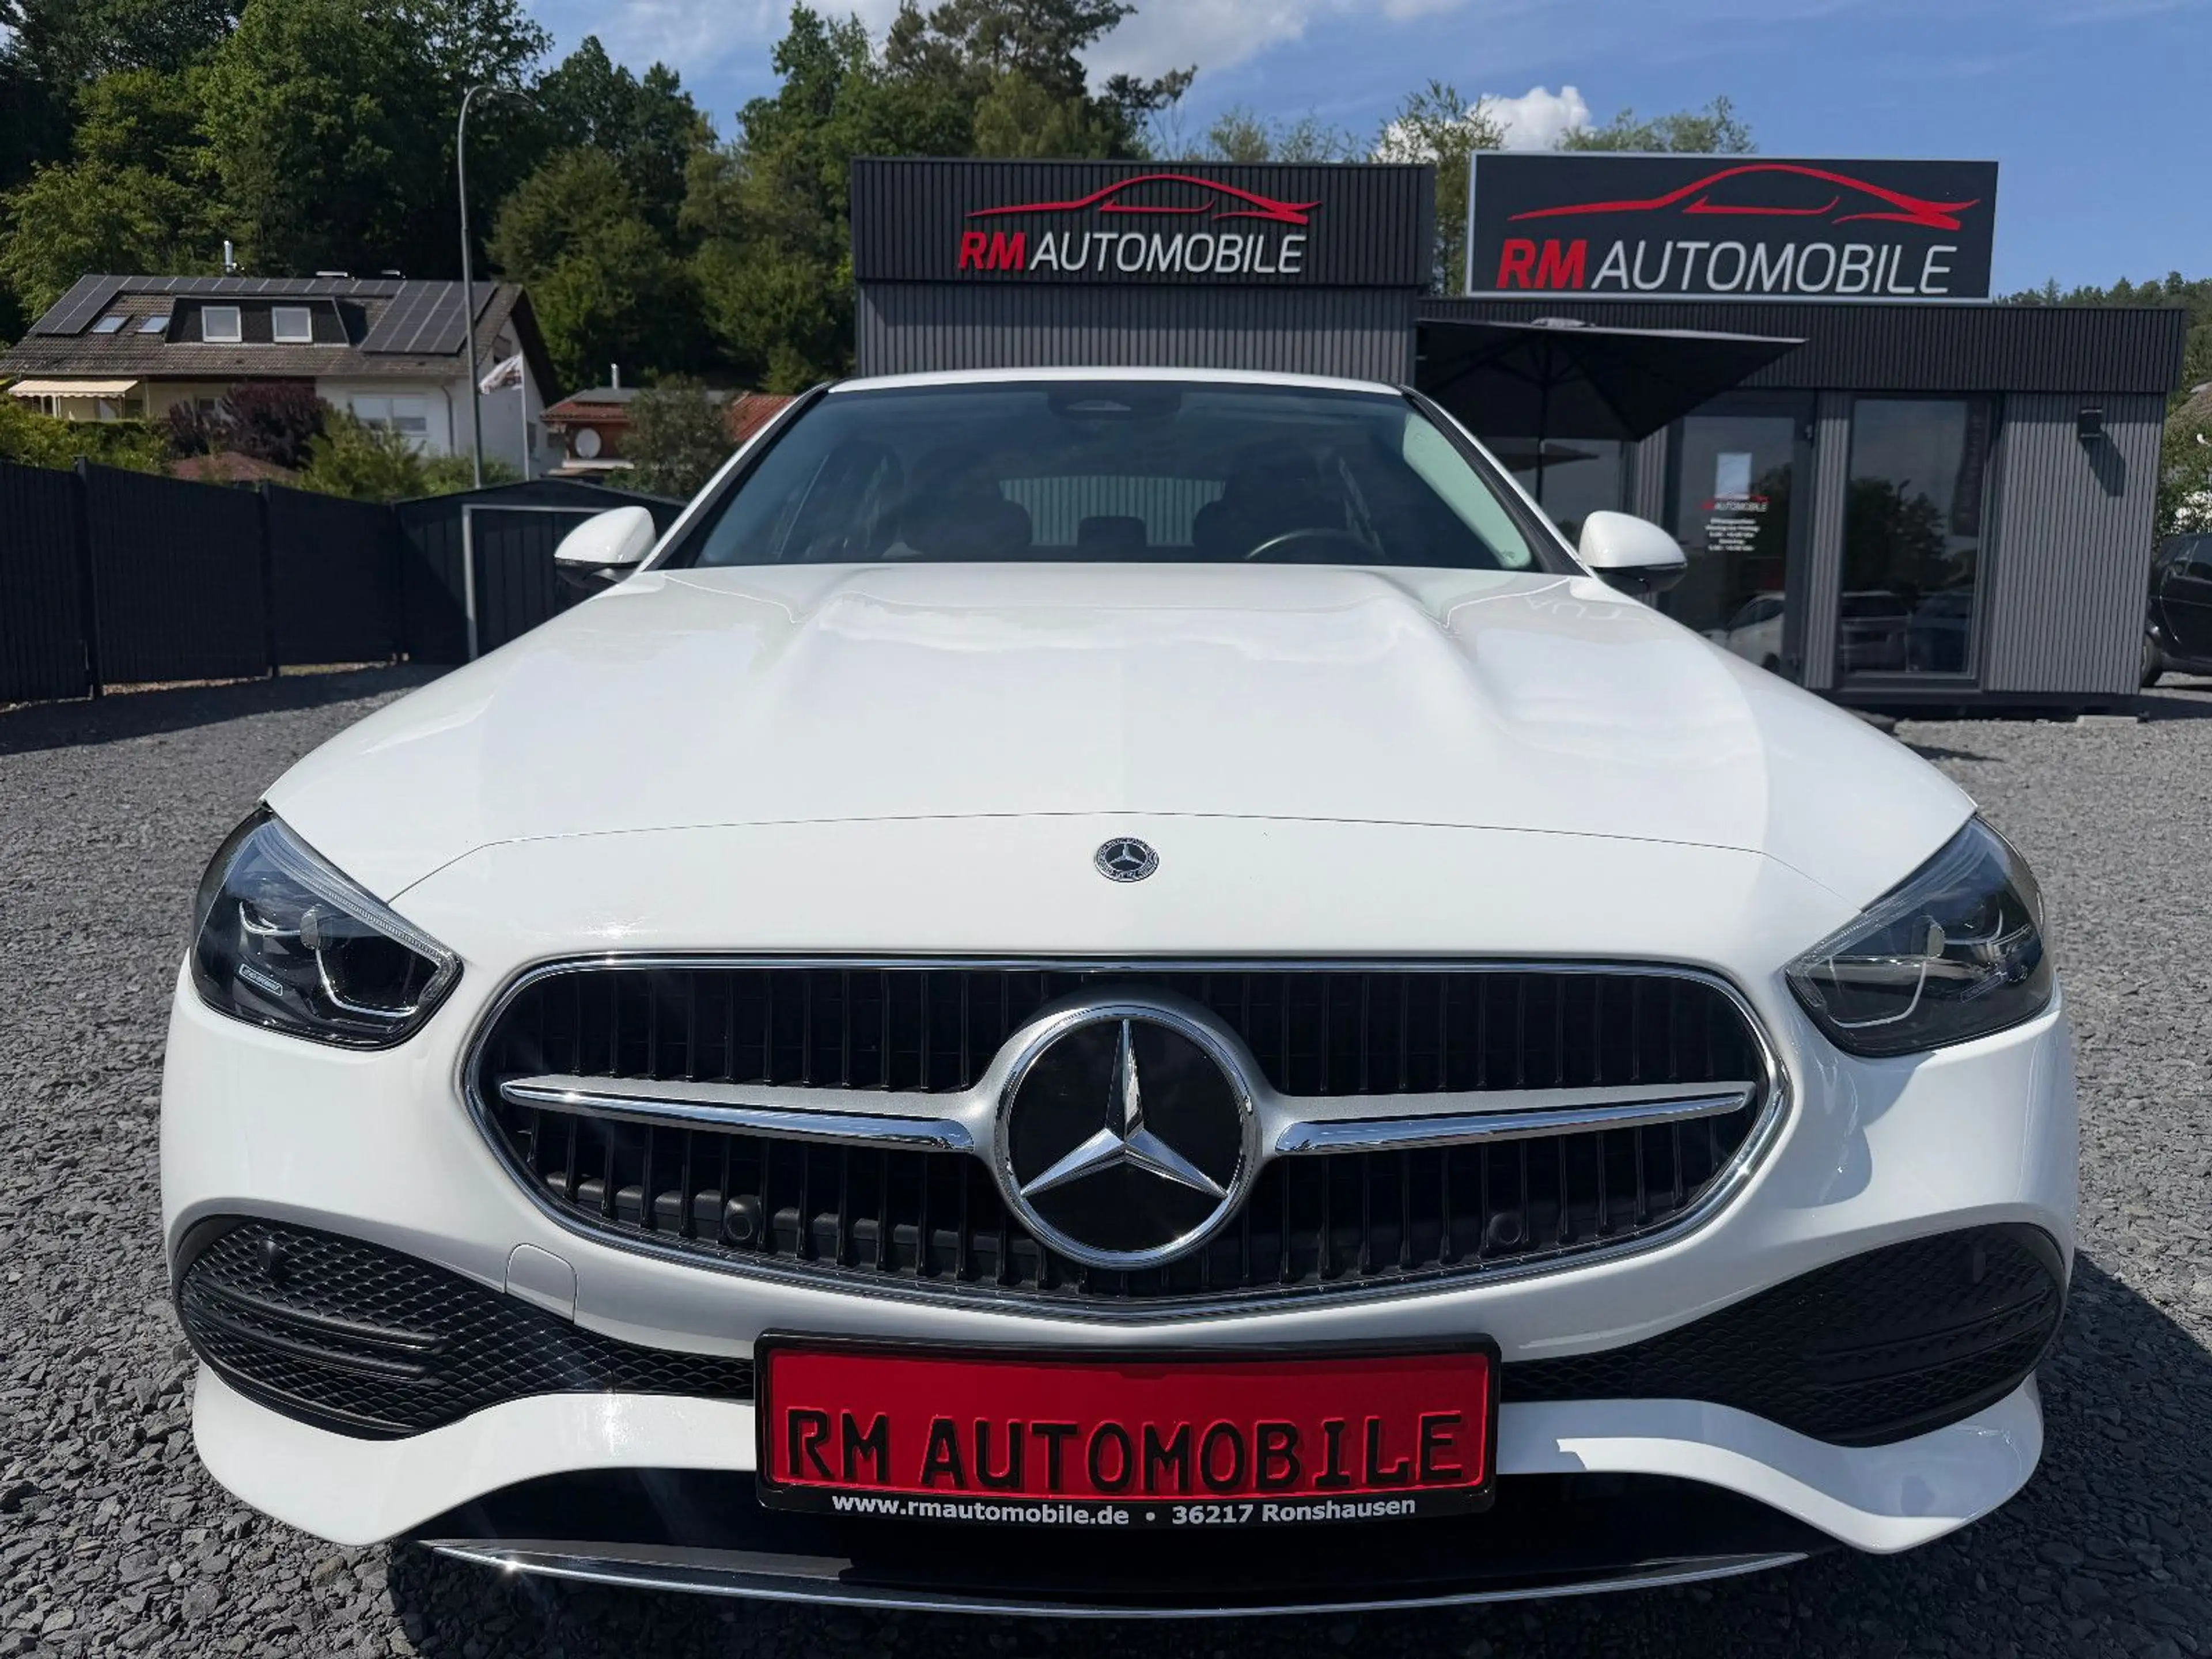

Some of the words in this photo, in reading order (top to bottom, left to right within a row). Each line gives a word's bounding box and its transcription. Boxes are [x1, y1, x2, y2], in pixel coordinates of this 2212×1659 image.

[959, 232, 1025, 270] RM
[1030, 232, 1306, 273] AUTOMOBILE
[1497, 238, 1587, 289] RM
[1591, 241, 1957, 294] AUTOMOBILE
[786, 1406, 890, 1484] RM
[920, 1410, 1462, 1494] AUTOMOBILE
[832, 1495, 1130, 1525] www.rmautomobile.de
[1172, 1504, 1253, 1525] 36217
[1262, 1498, 1416, 1522] Ronshausen
